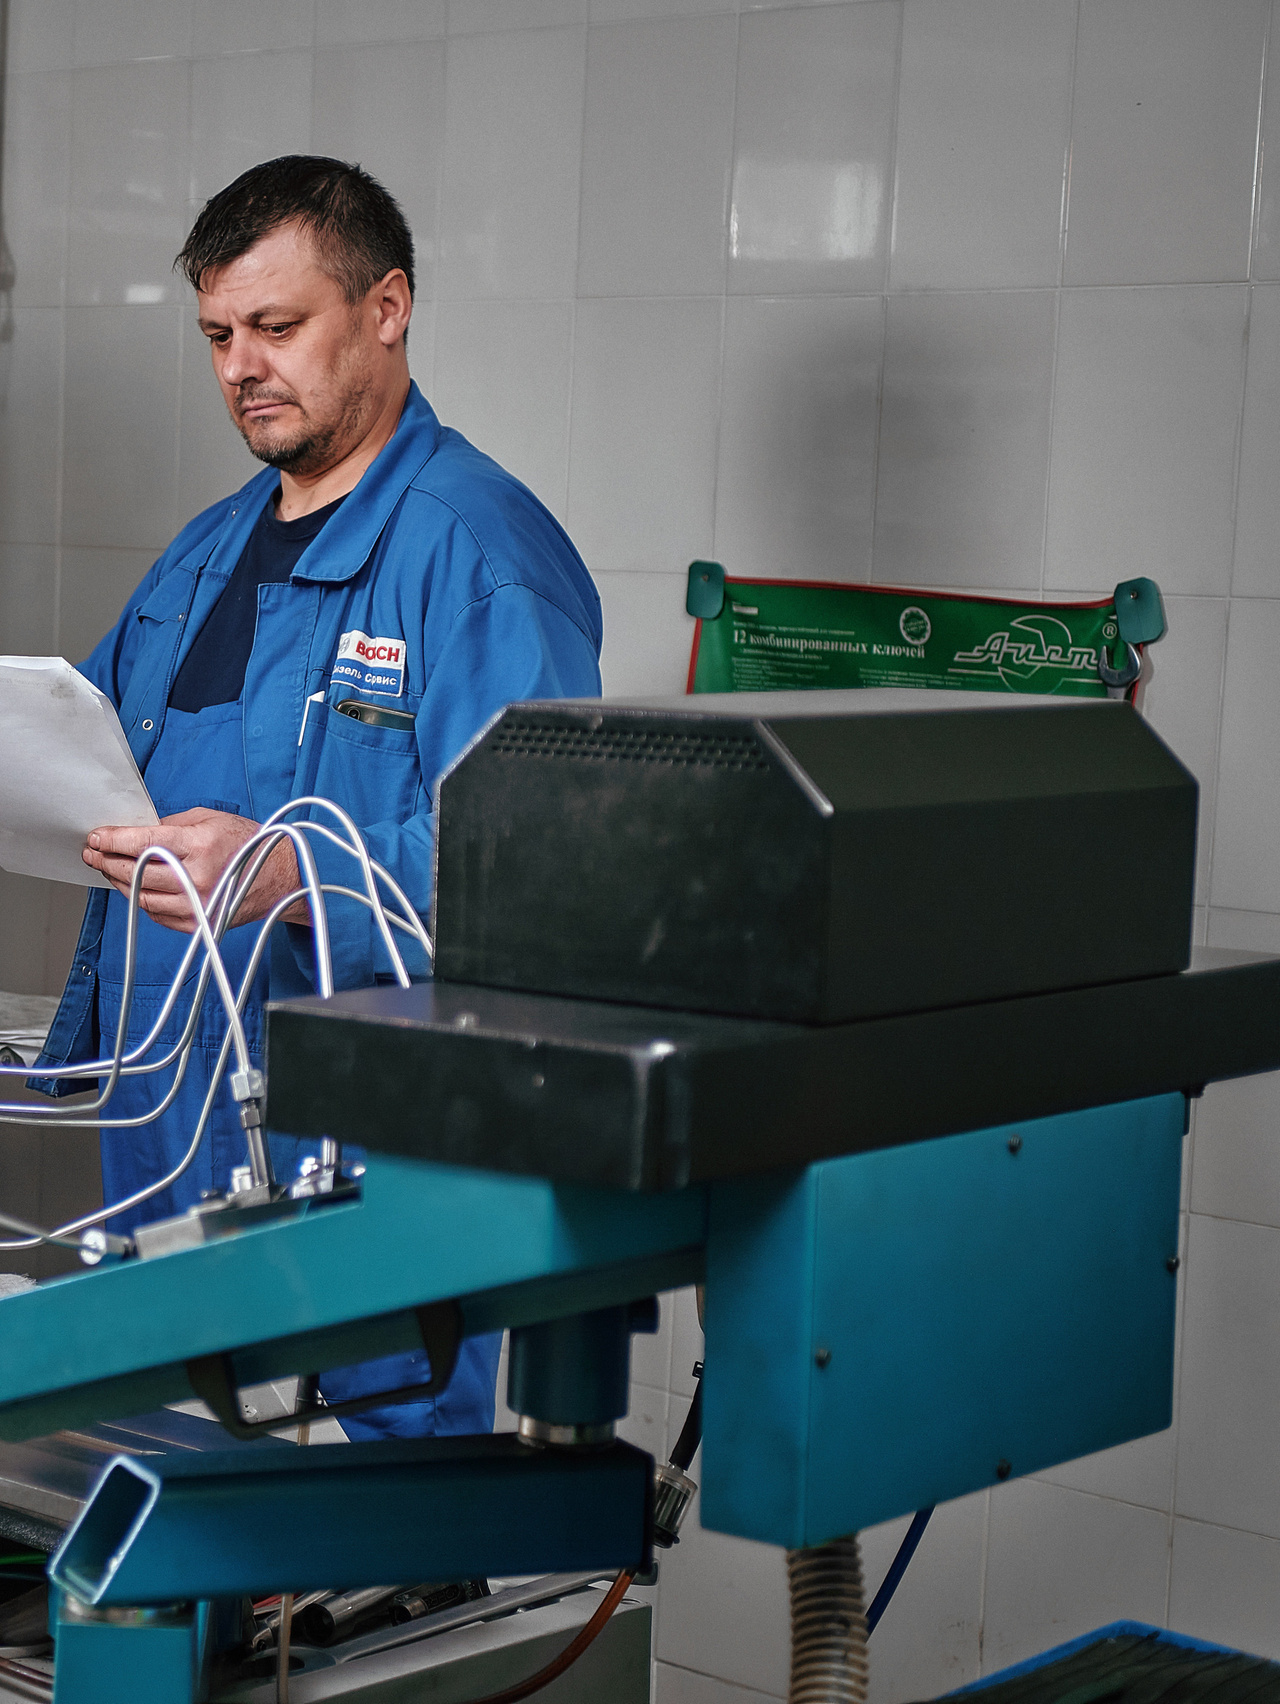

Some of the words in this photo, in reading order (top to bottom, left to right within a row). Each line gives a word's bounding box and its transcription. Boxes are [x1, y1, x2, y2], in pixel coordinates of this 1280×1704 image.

[356, 640, 400, 663] BOCH
[733, 629, 747, 644] 12
[750, 632, 868, 655] комбинированных
[872, 643, 926, 659] ключей
[333, 664, 362, 679] изель
